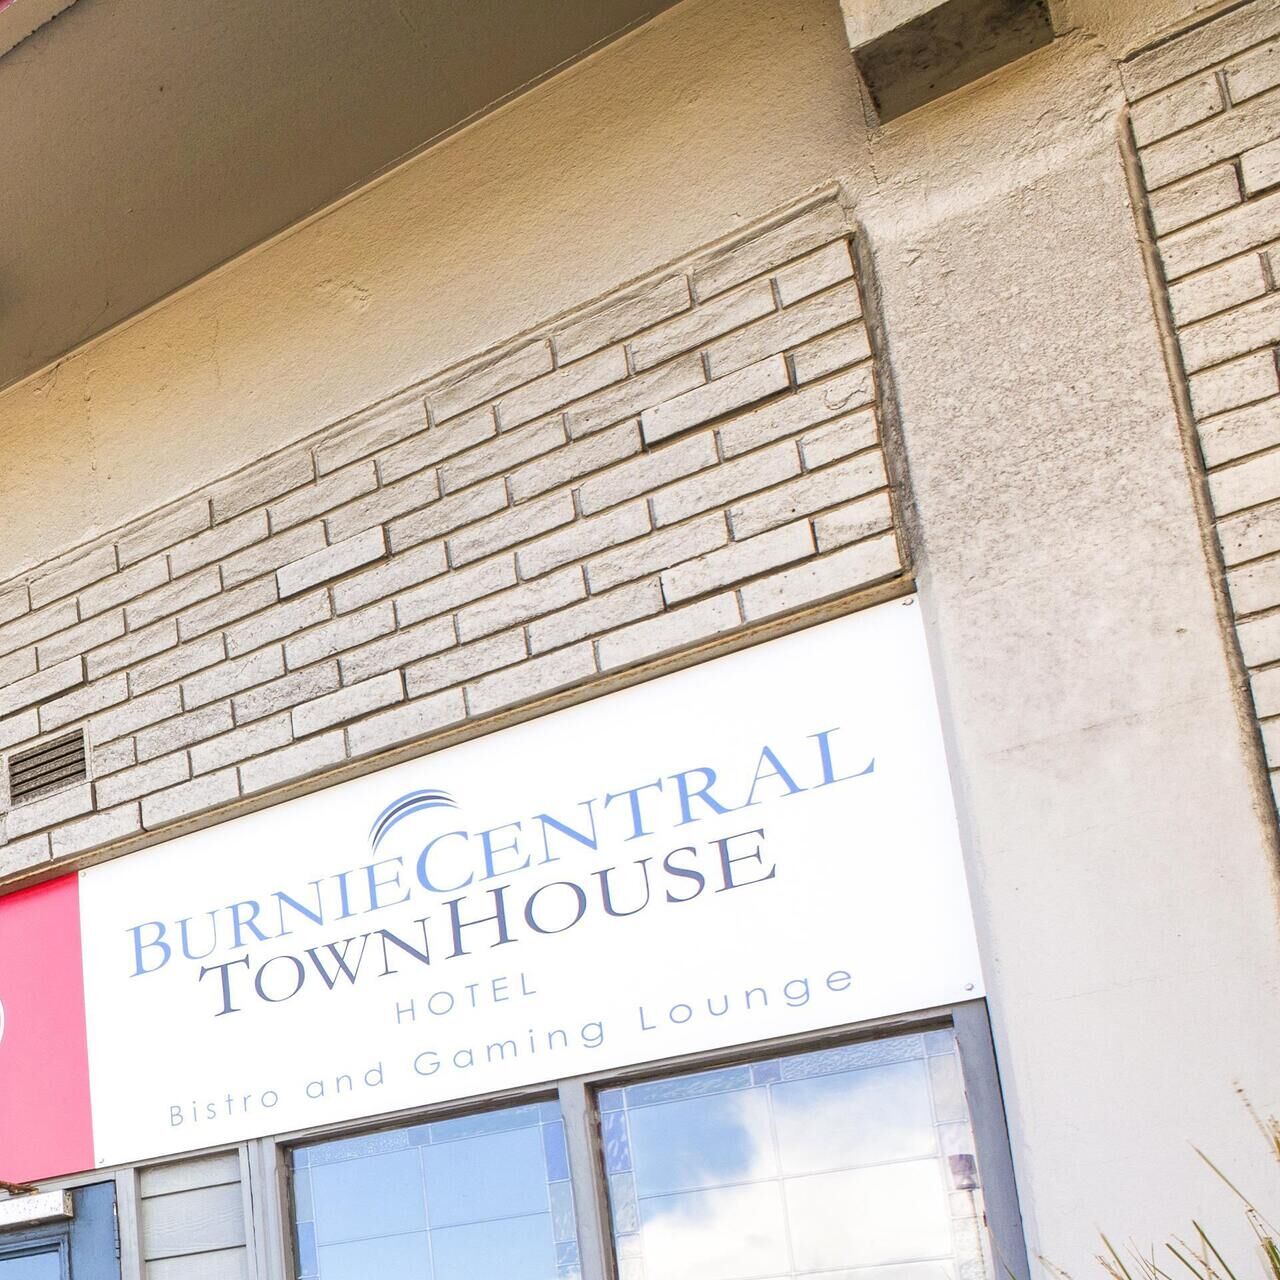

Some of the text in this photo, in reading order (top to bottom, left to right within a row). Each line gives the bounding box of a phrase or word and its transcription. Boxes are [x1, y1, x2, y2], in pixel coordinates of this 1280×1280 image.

[169, 967, 854, 1127] Bistro and Gaming Lounge
[396, 972, 538, 1025] HOTEL
